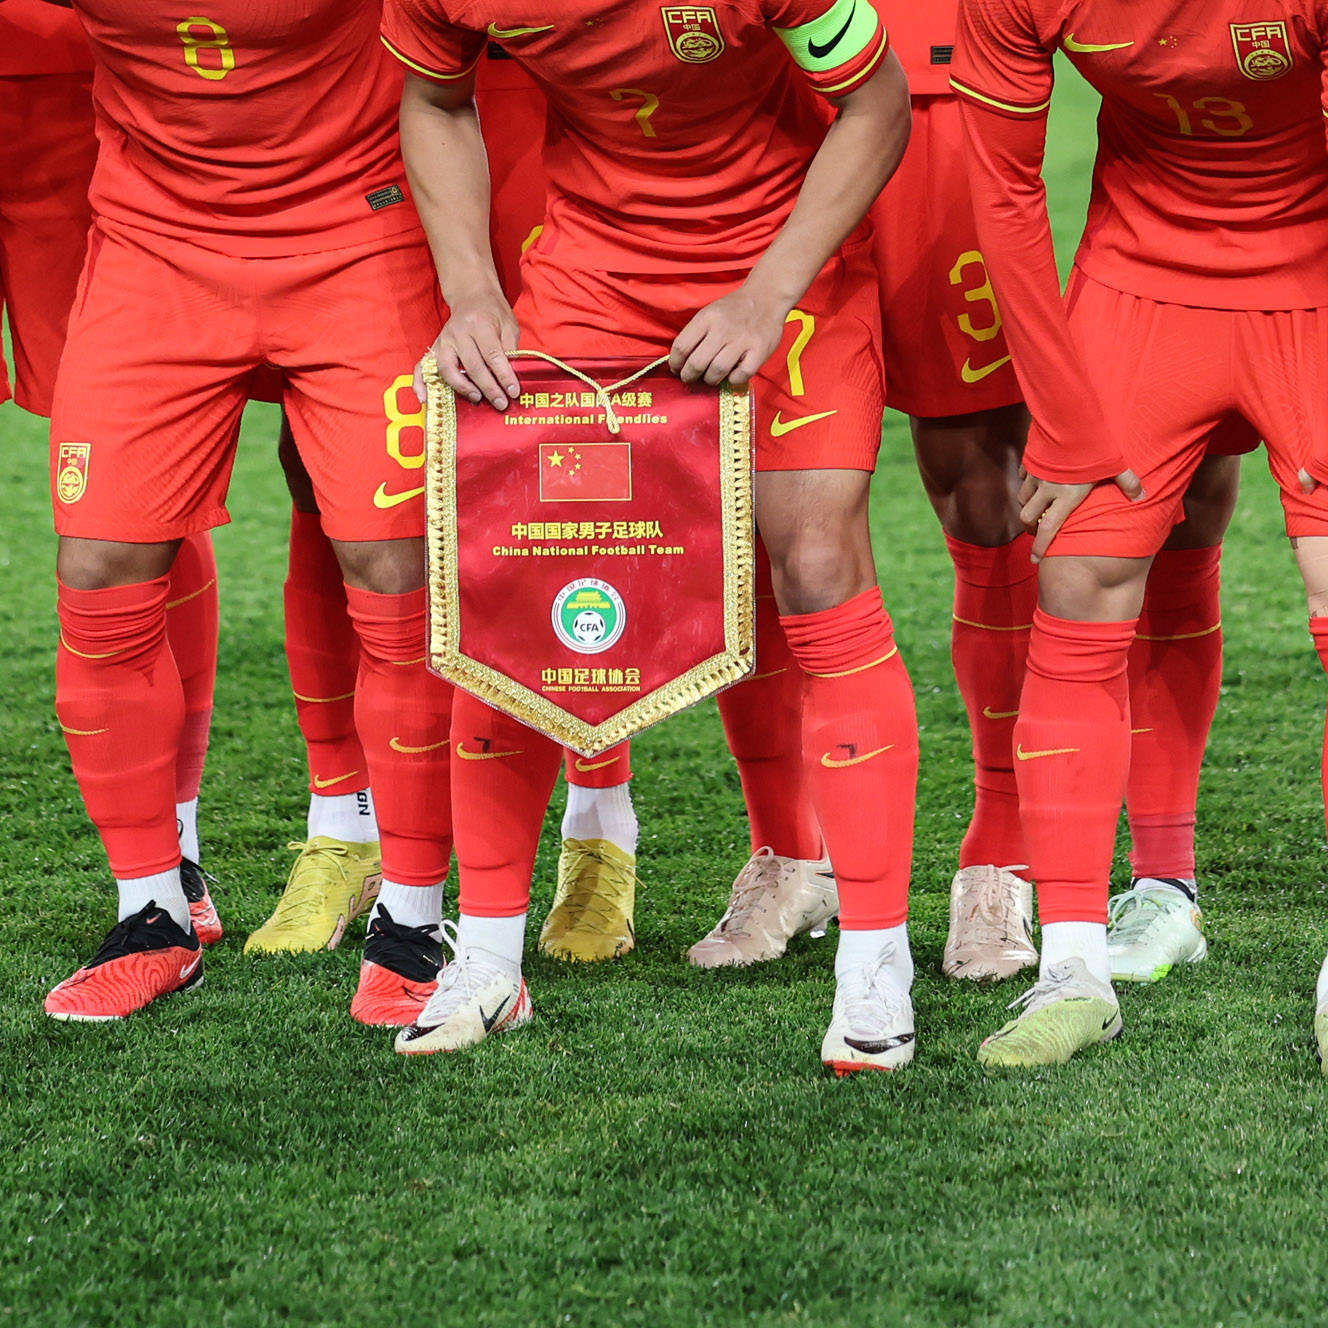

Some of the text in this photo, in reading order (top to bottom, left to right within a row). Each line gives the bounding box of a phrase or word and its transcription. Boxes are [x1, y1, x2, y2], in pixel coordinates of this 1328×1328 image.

[667, 11, 712, 24] CFA
[1236, 27, 1282, 41] CFA
[176, 16, 236, 80] 8
[1251, 40, 1270, 49] 中国
[609, 87, 660, 138] 7
[1153, 92, 1253, 136] 13
[949, 250, 1002, 341] 3
[784, 308, 816, 397] 7
[383, 374, 425, 469] 8
[504, 414, 668, 425] International Fendlies
[61, 447, 87, 458] CFA
[511, 521, 664, 540] 中国国家男子足球队
[492, 544, 684, 556] China National Football Team
[579, 623, 599, 632] CFA
[541, 667, 641, 685] 中国足球协会
